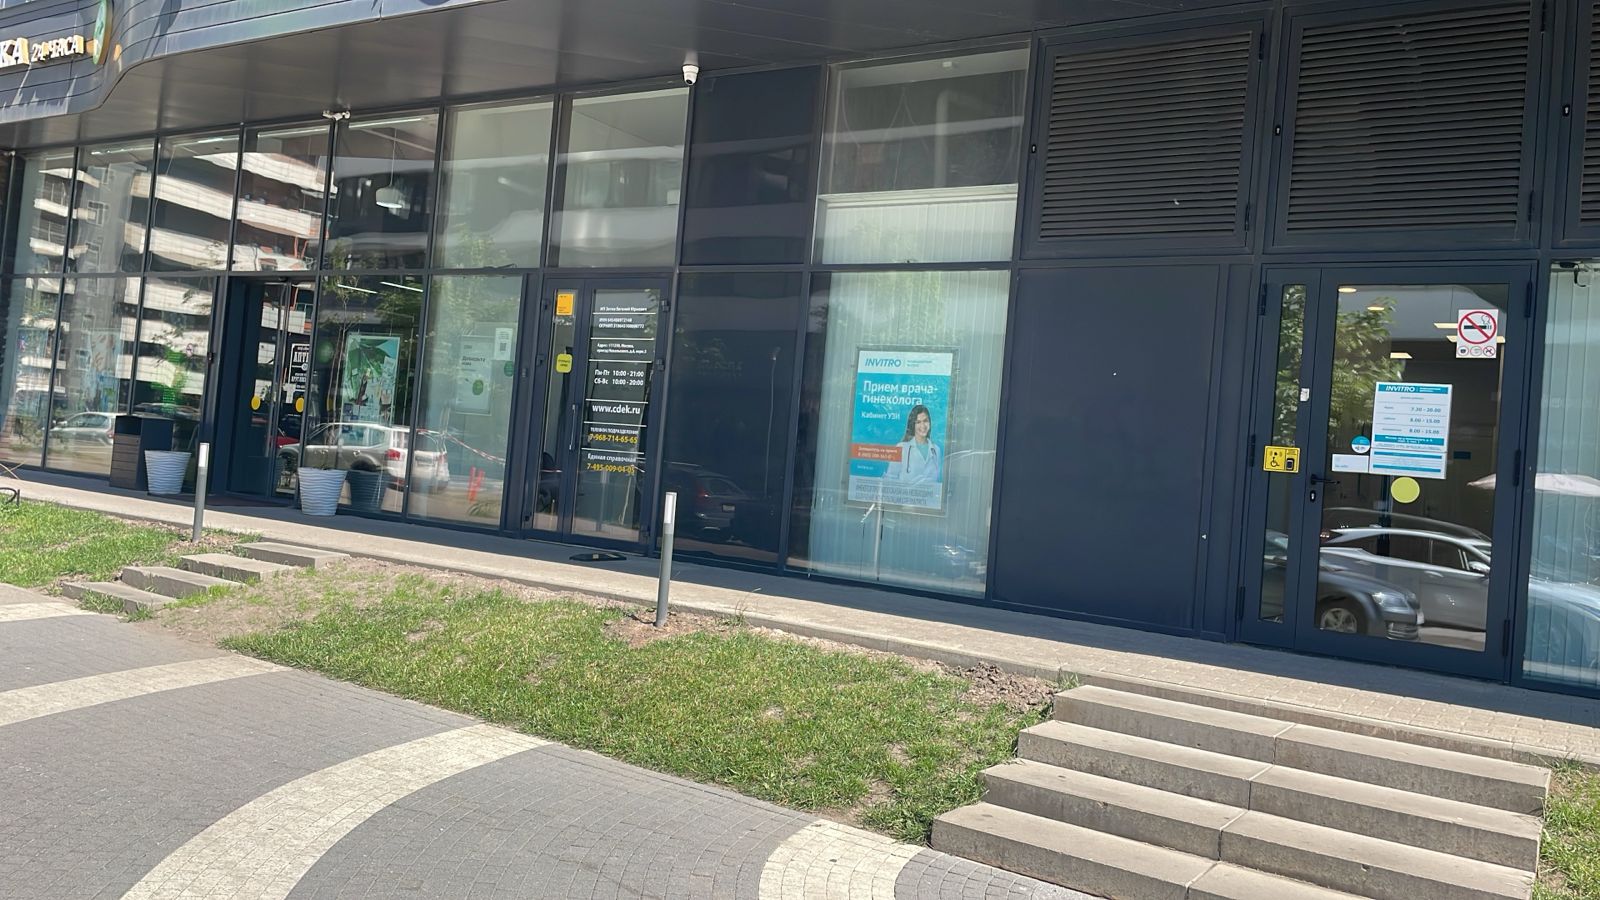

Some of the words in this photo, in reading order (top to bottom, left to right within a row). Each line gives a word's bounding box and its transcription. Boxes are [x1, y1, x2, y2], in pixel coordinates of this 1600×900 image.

[865, 358, 902, 368] INVITRO
[863, 381, 899, 394] Прием
[901, 384, 938, 395] врача-
[862, 394, 922, 405] гинеколога
[592, 405, 641, 414] www.cdek.ru
